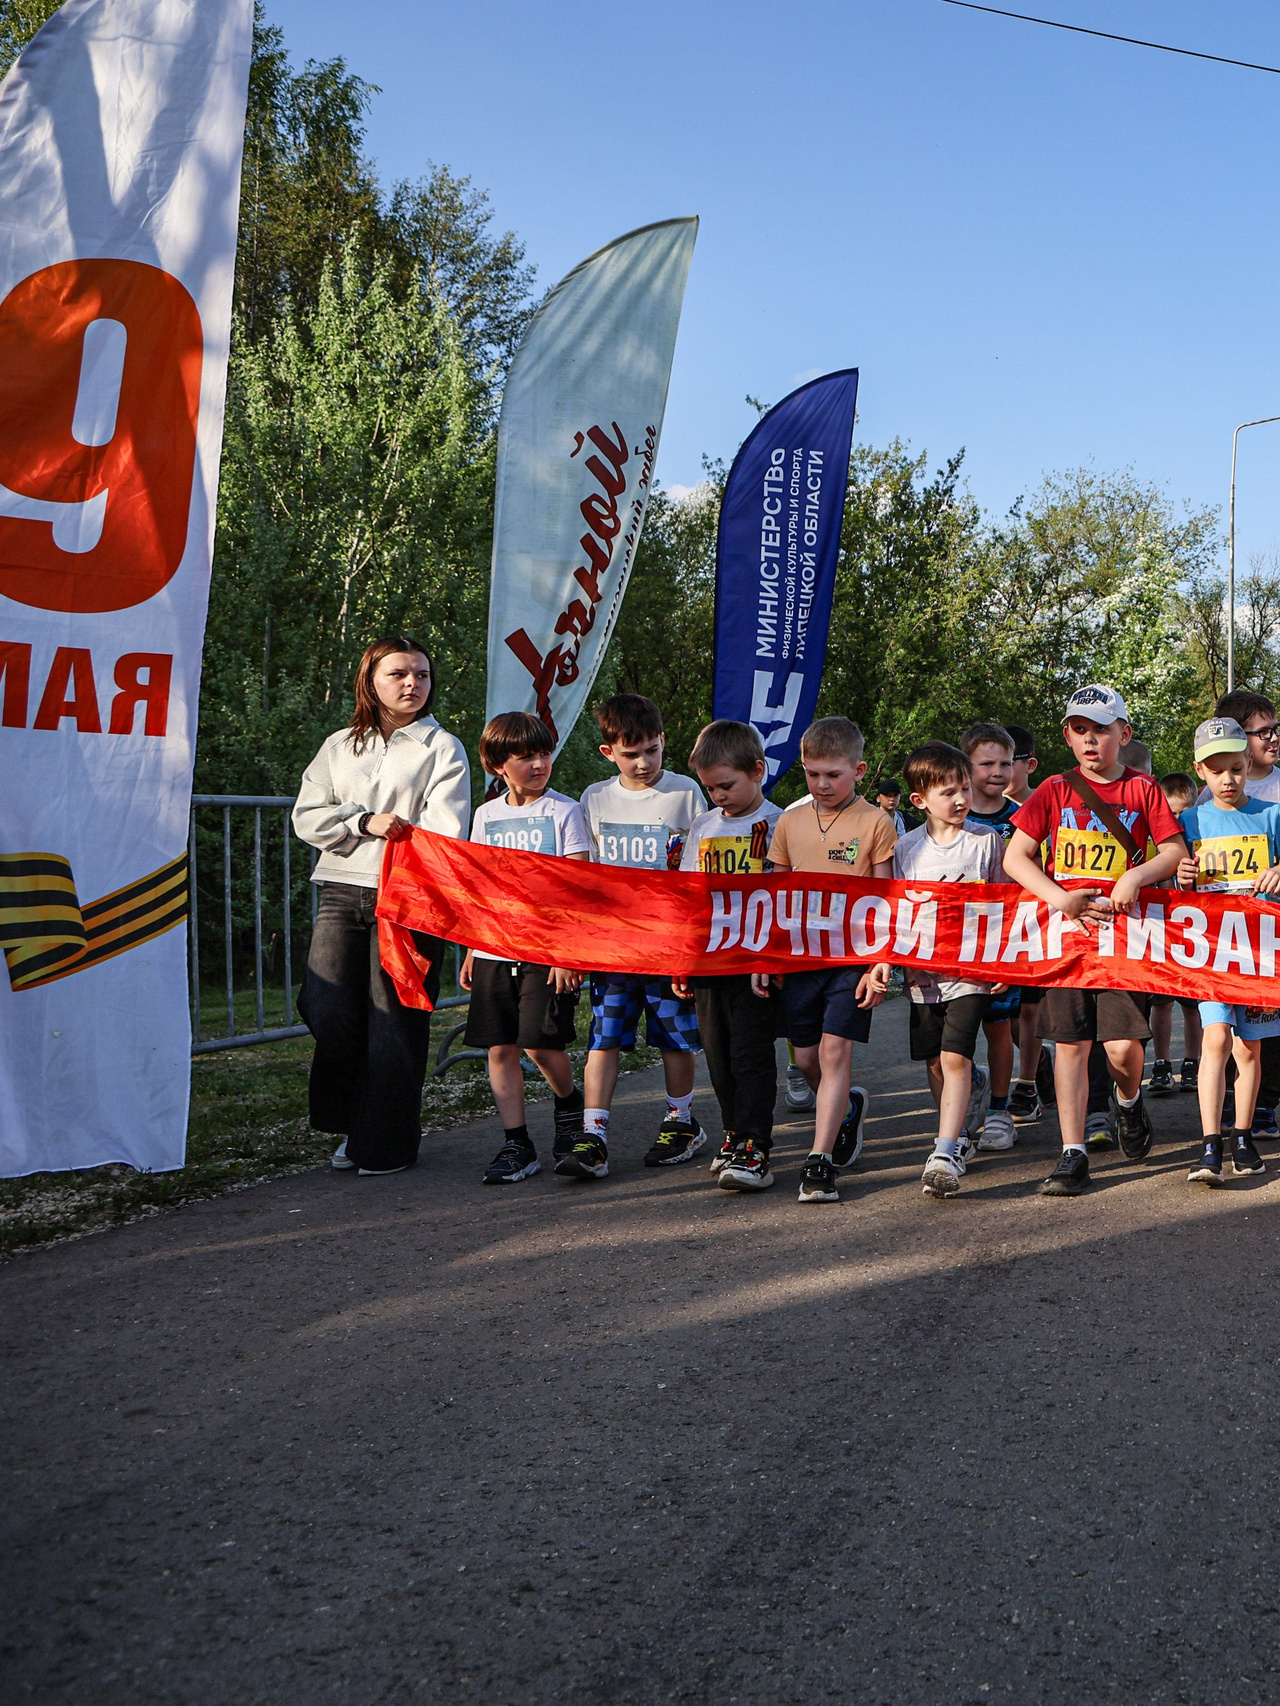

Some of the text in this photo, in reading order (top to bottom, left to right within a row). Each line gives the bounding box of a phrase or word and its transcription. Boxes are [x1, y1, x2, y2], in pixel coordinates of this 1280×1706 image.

[0, 258, 204, 613] 9
[803, 450, 824, 547] ОБЛАСТИ
[755, 448, 786, 658] МИНИСТЕРСТВО
[782, 447, 803, 659] ФИЗИЧЕСКОЙ КУЛЬТУРЫ И СПОРТА
[494, 829, 543, 852] 3089
[607, 835, 658, 863] 3103
[704, 849, 750, 874] 0104
[1064, 842, 1116, 871] 0127
[1205, 848, 1258, 877] 0124
[706, 889, 938, 960] НОЧНОЙ
